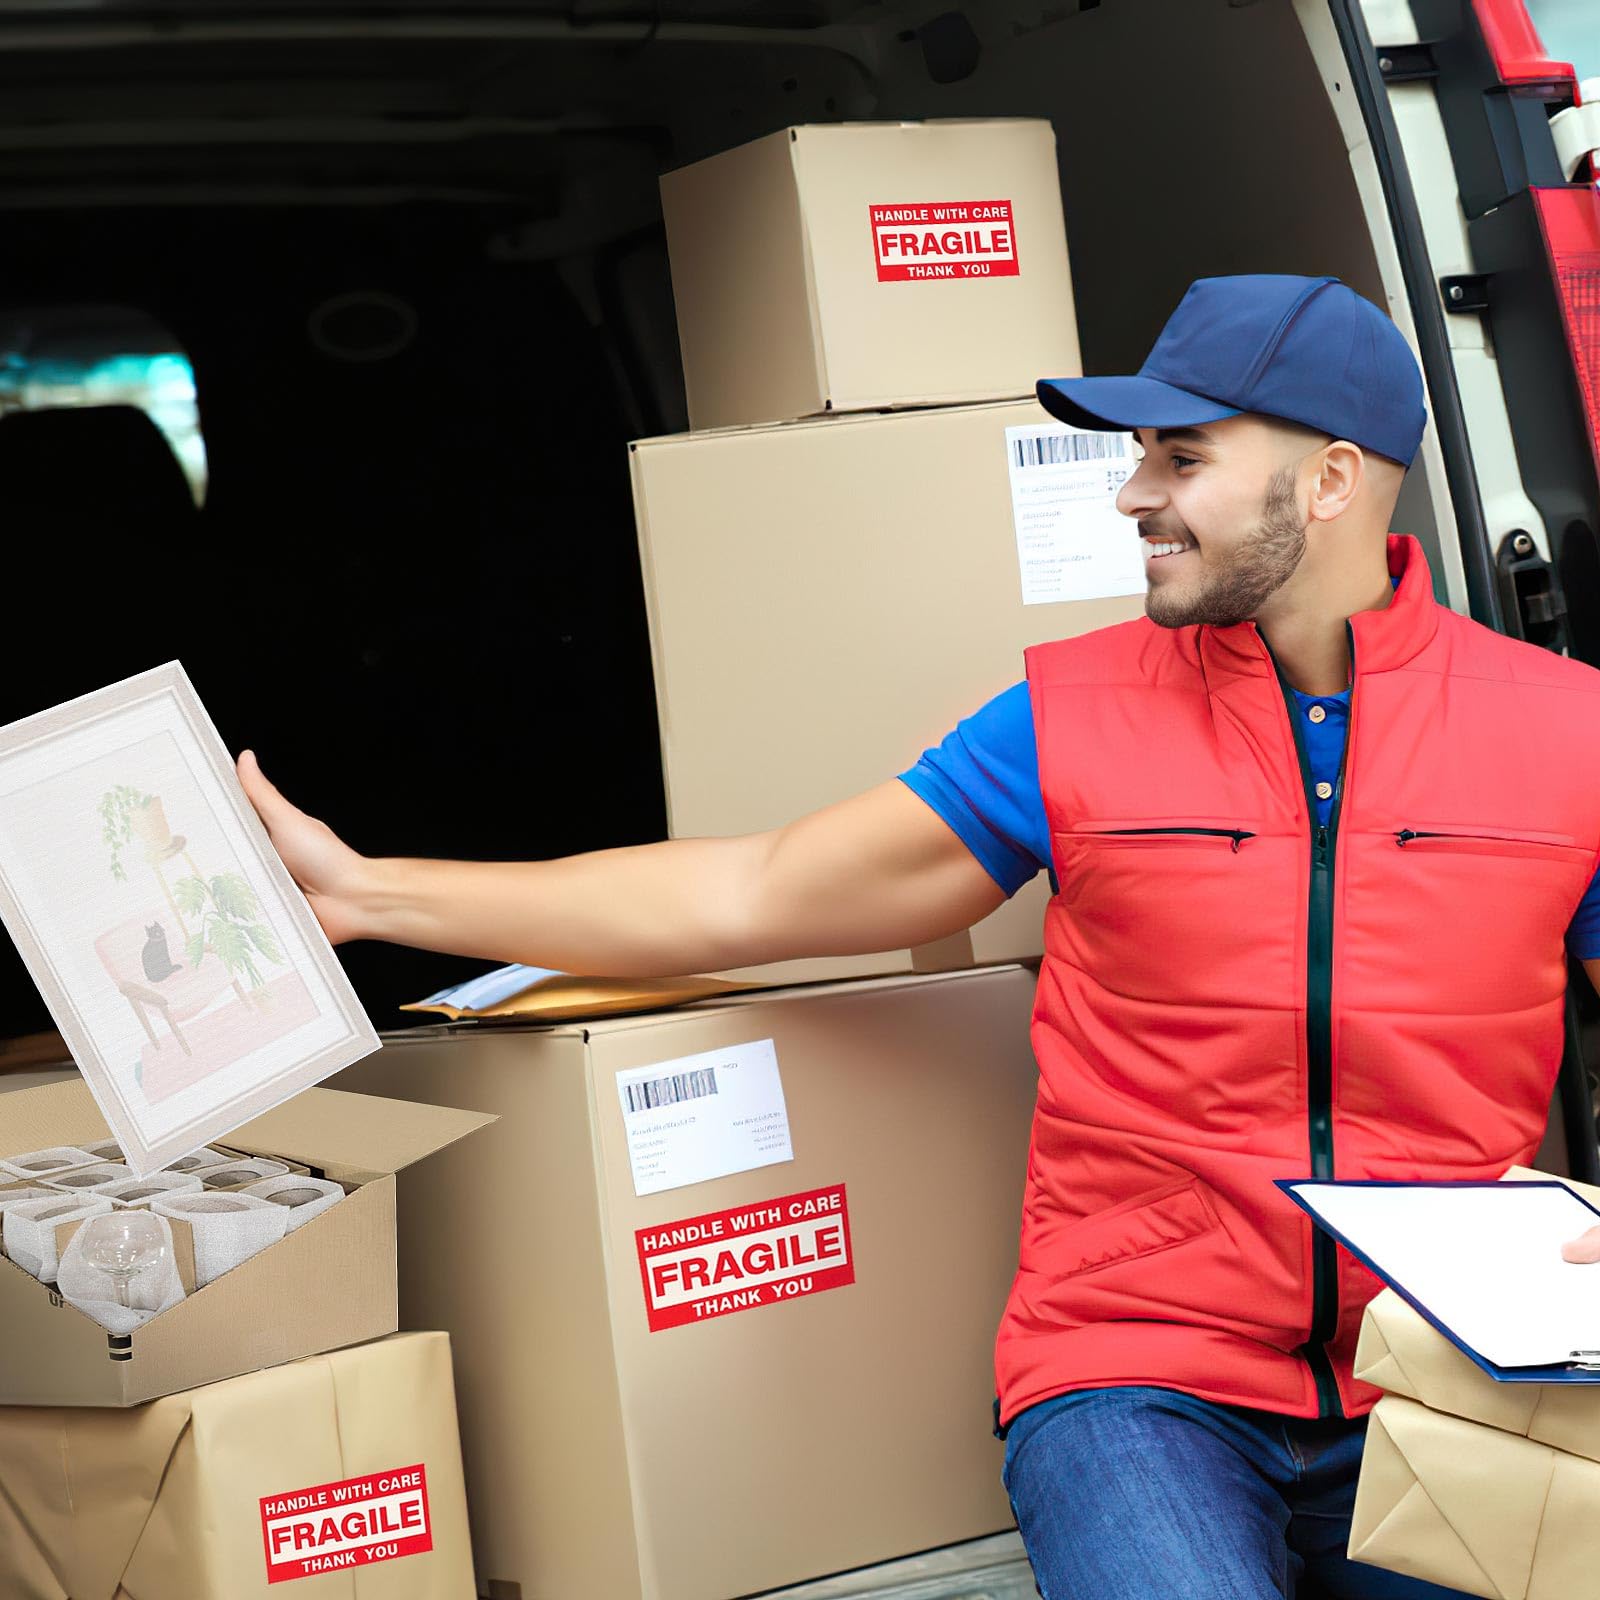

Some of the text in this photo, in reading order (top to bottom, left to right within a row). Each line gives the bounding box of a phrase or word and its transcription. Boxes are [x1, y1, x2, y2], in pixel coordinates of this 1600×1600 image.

[874, 206, 1009, 222] HANDLE WITH CARE
[880, 229, 1010, 258] FRAGILE
[907, 263, 990, 278] THANK YOU
[643, 1193, 842, 1252] HANDLE WITH CARE
[652, 1225, 842, 1298] FRAGILE
[692, 1276, 813, 1317] THANK YOU
[265, 1472, 421, 1516] HANDLE WITH CARE
[272, 1499, 422, 1555] FRAGILE
[301, 1543, 398, 1573] THANK YOU
